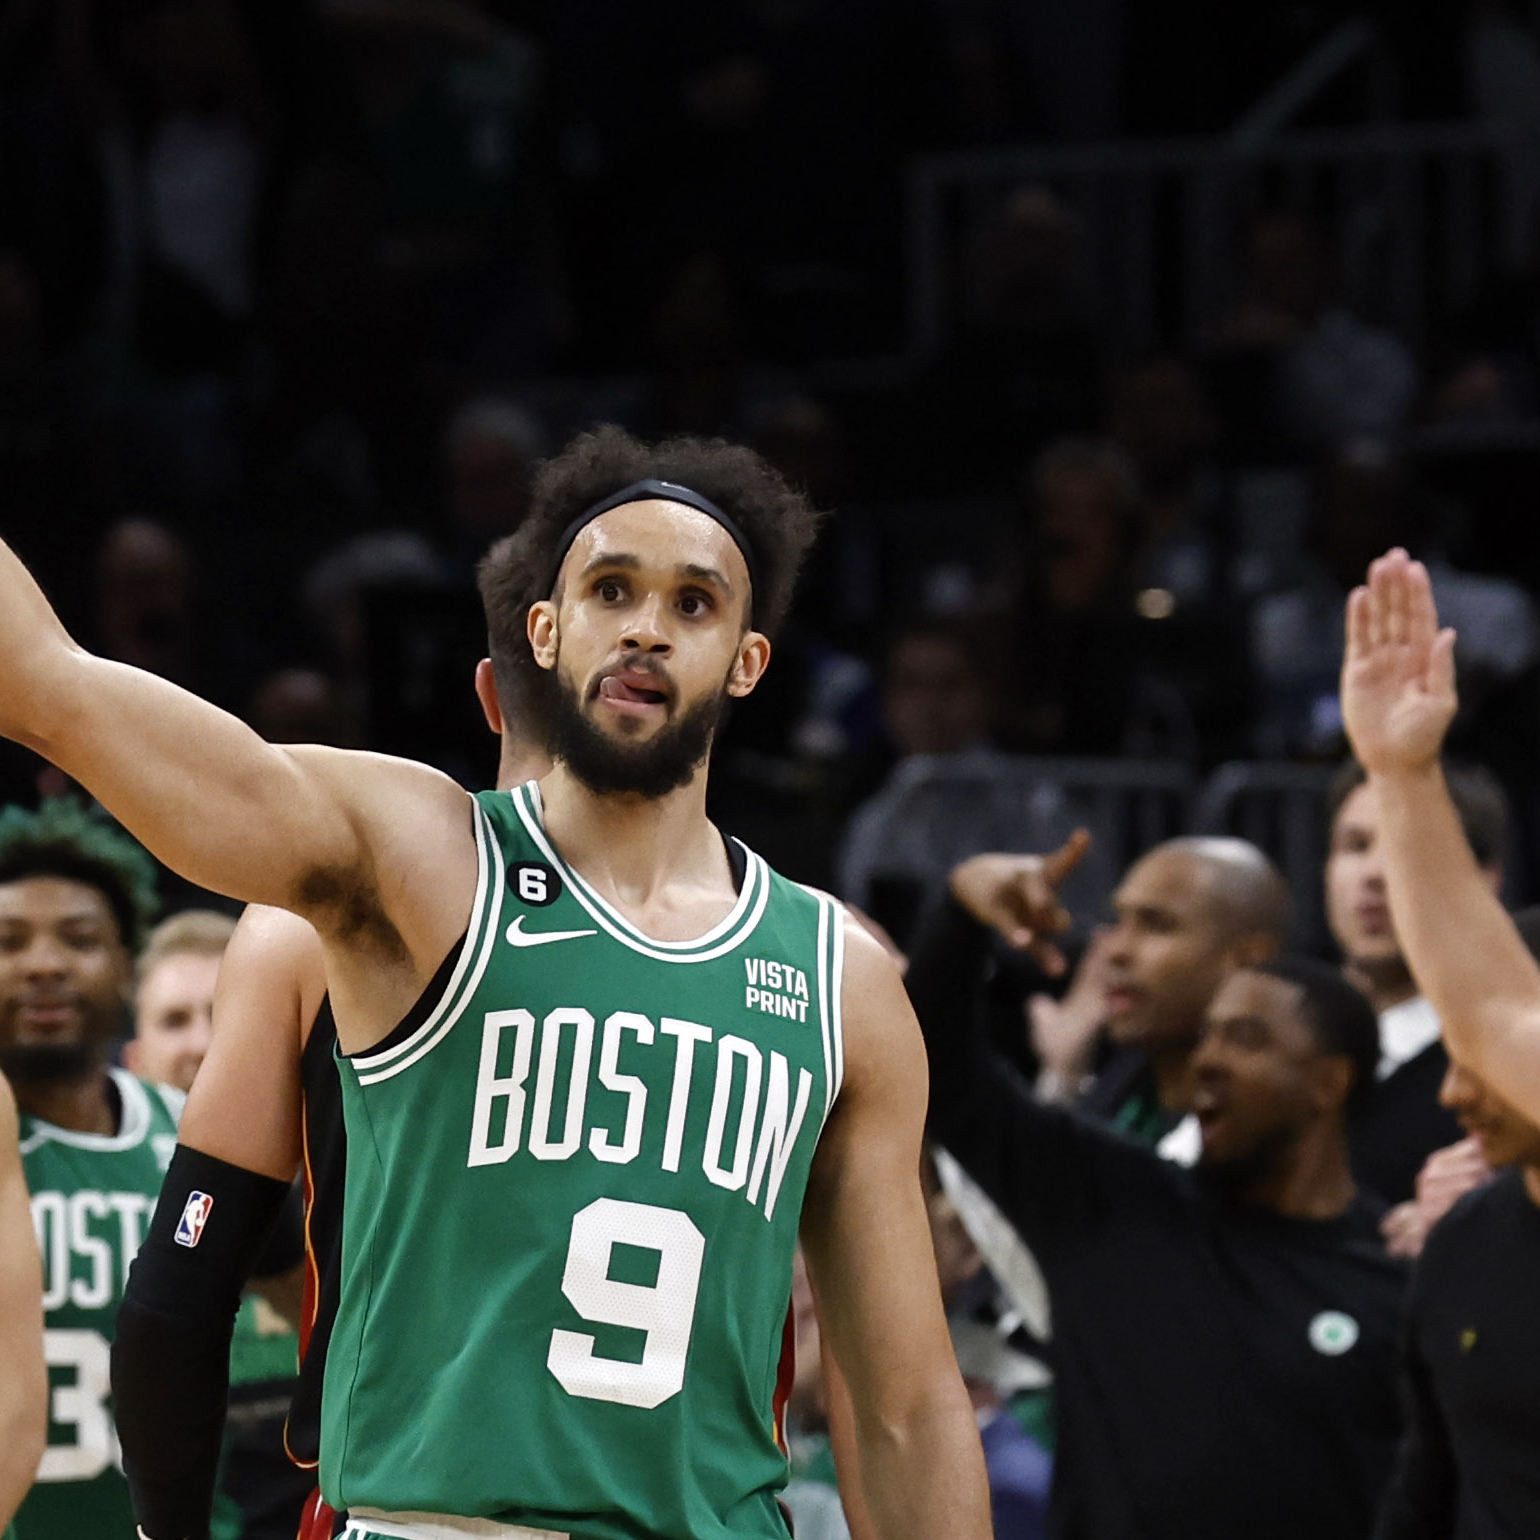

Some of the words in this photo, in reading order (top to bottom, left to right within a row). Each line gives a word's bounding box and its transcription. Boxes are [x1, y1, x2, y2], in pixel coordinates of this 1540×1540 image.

[519, 867, 547, 902] 6
[744, 958, 809, 1001] VISTA
[746, 986, 809, 1023] PRINT
[467, 1007, 812, 1222] BOSTON
[547, 1197, 705, 1409] 9
[36, 1329, 128, 1482] 3
